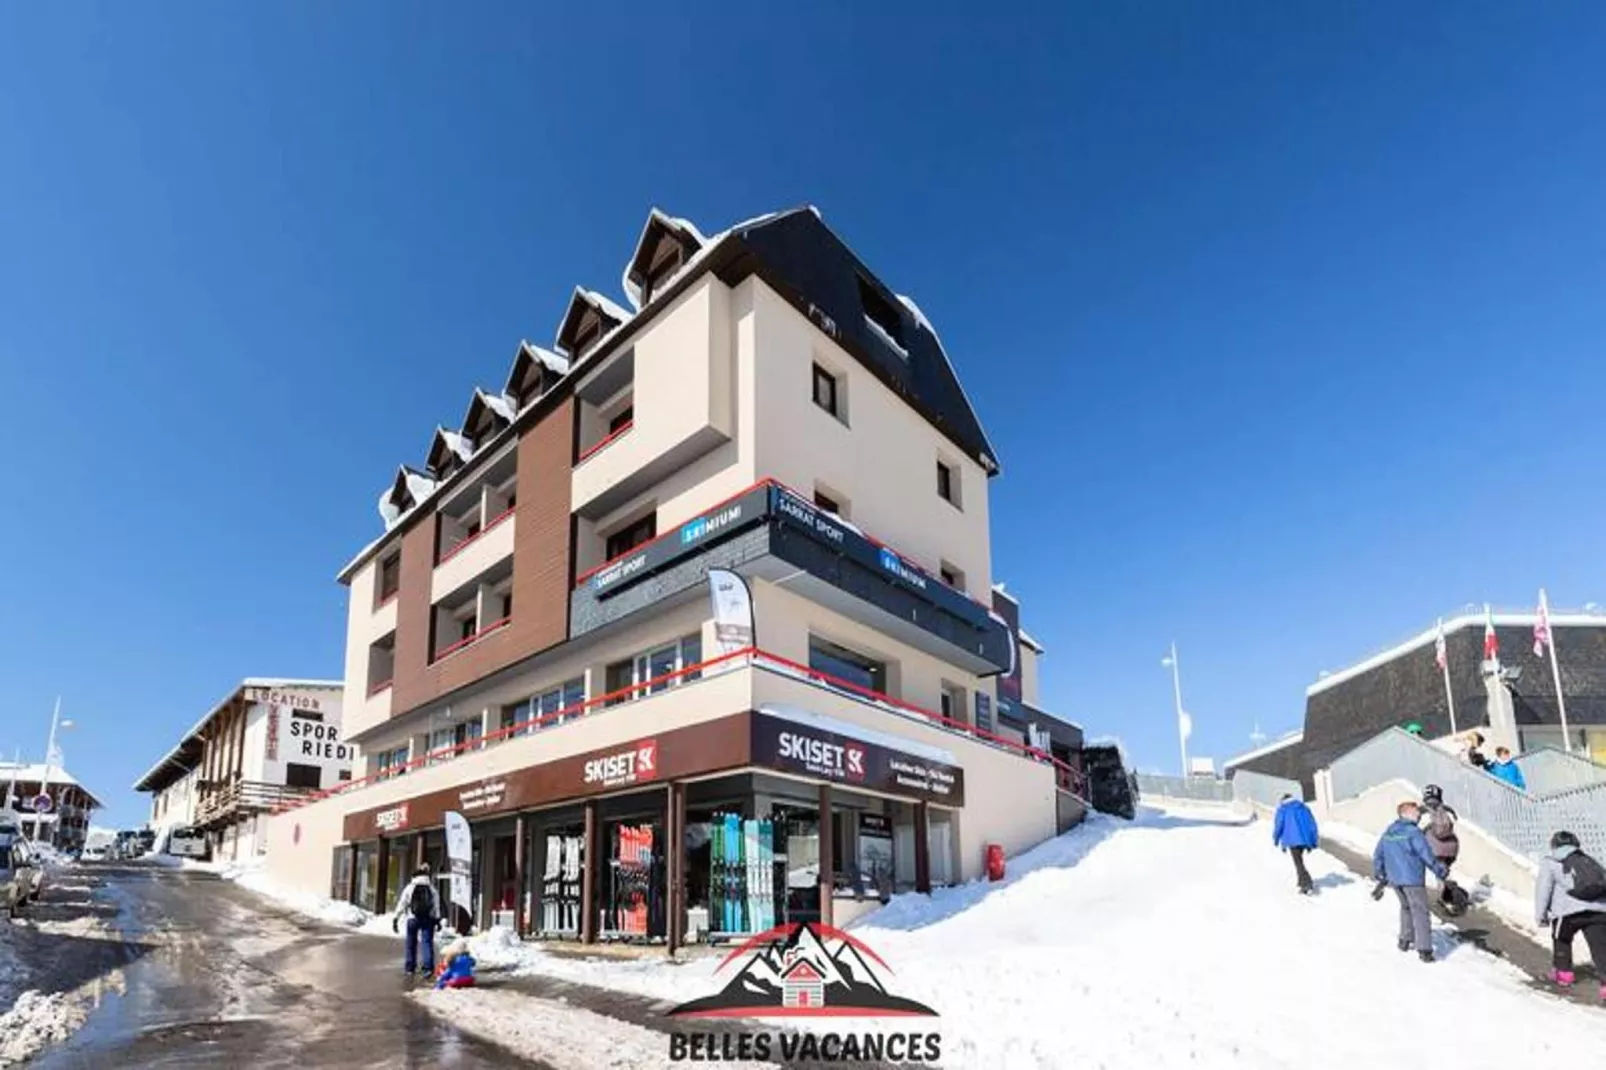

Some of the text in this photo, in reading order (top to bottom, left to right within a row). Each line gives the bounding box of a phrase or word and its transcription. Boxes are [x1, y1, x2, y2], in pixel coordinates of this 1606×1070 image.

[815, 517, 844, 543] SPORT
[252, 689, 320, 709] LOCATION
[290, 721, 338, 741] SPOR
[778, 732, 845, 768] SKISET
[583, 751, 637, 783] SKISET
